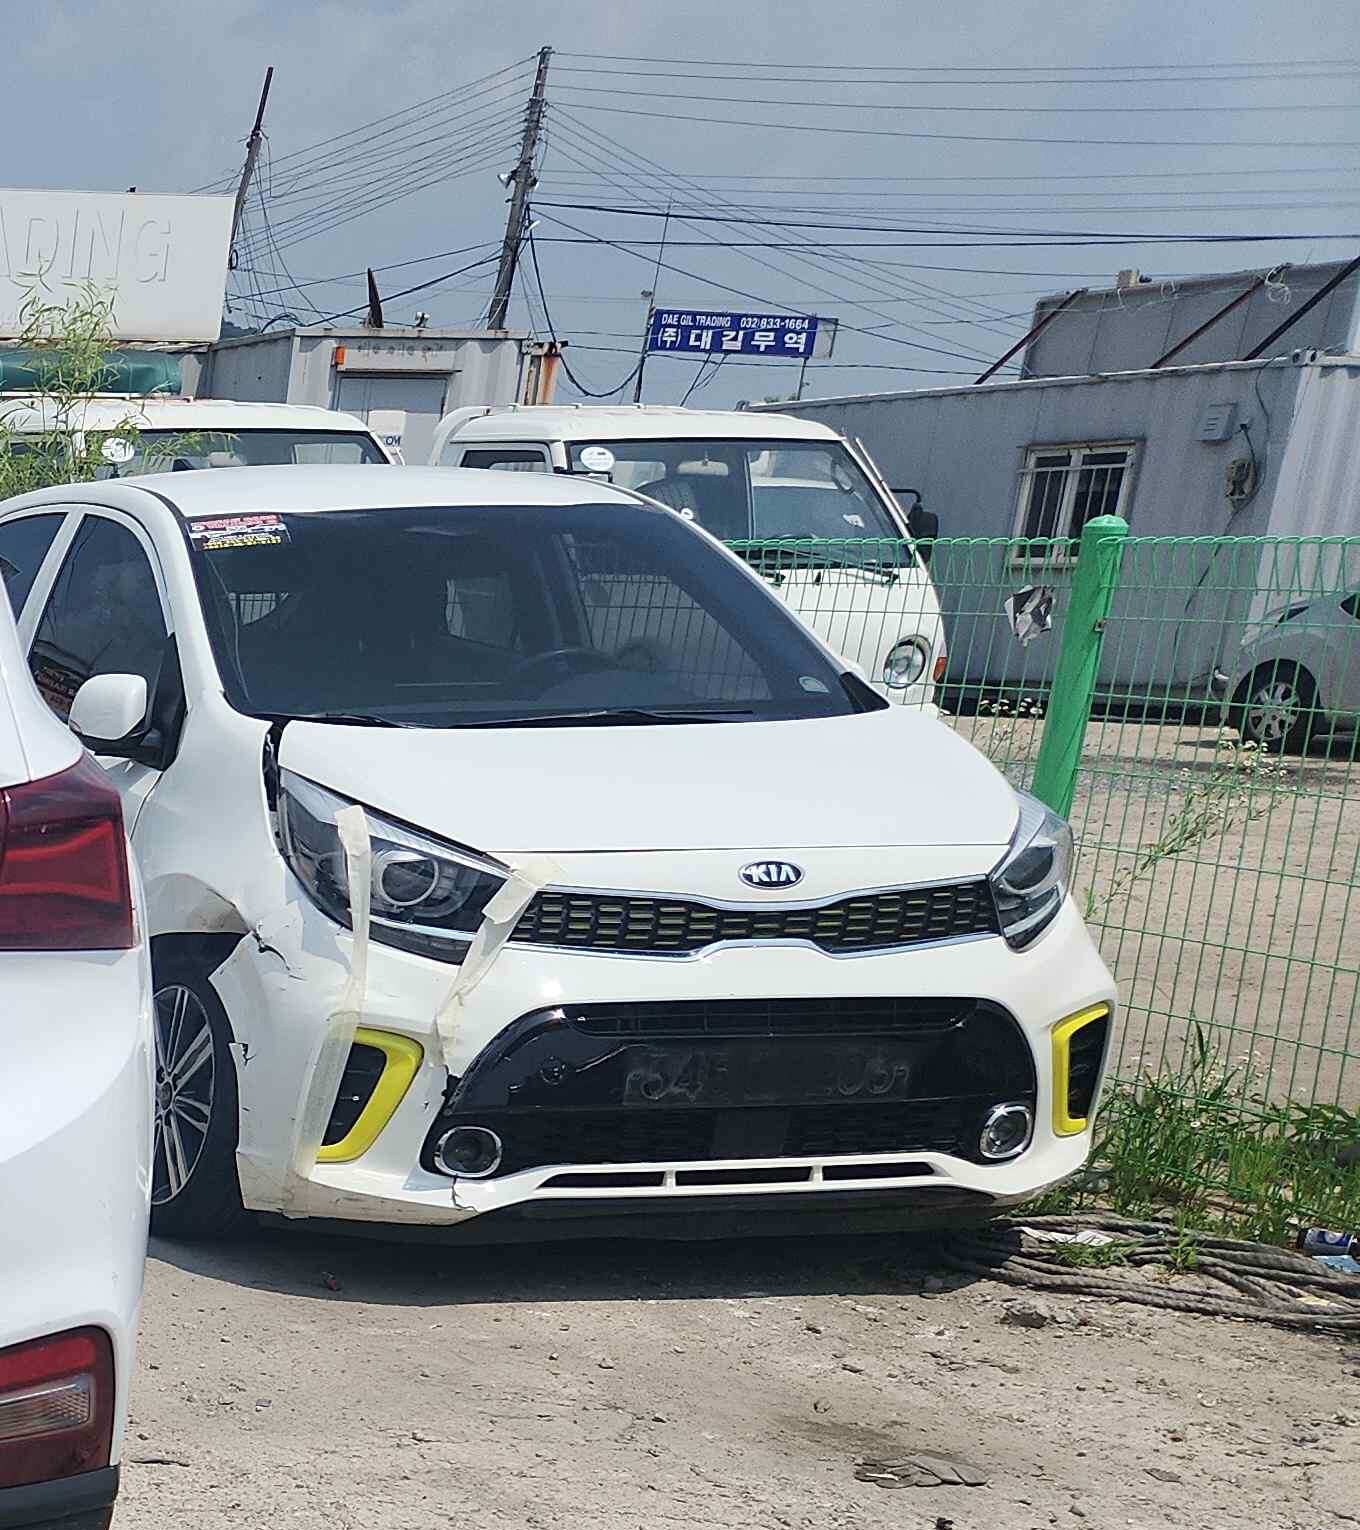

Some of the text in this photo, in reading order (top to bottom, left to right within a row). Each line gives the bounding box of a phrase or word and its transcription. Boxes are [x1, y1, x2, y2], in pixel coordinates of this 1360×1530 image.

[661, 313, 679, 326] DAE
[680, 314, 695, 327] GIL
[695, 315, 731, 328] TRADING
[750, 864, 796, 883] KIA
